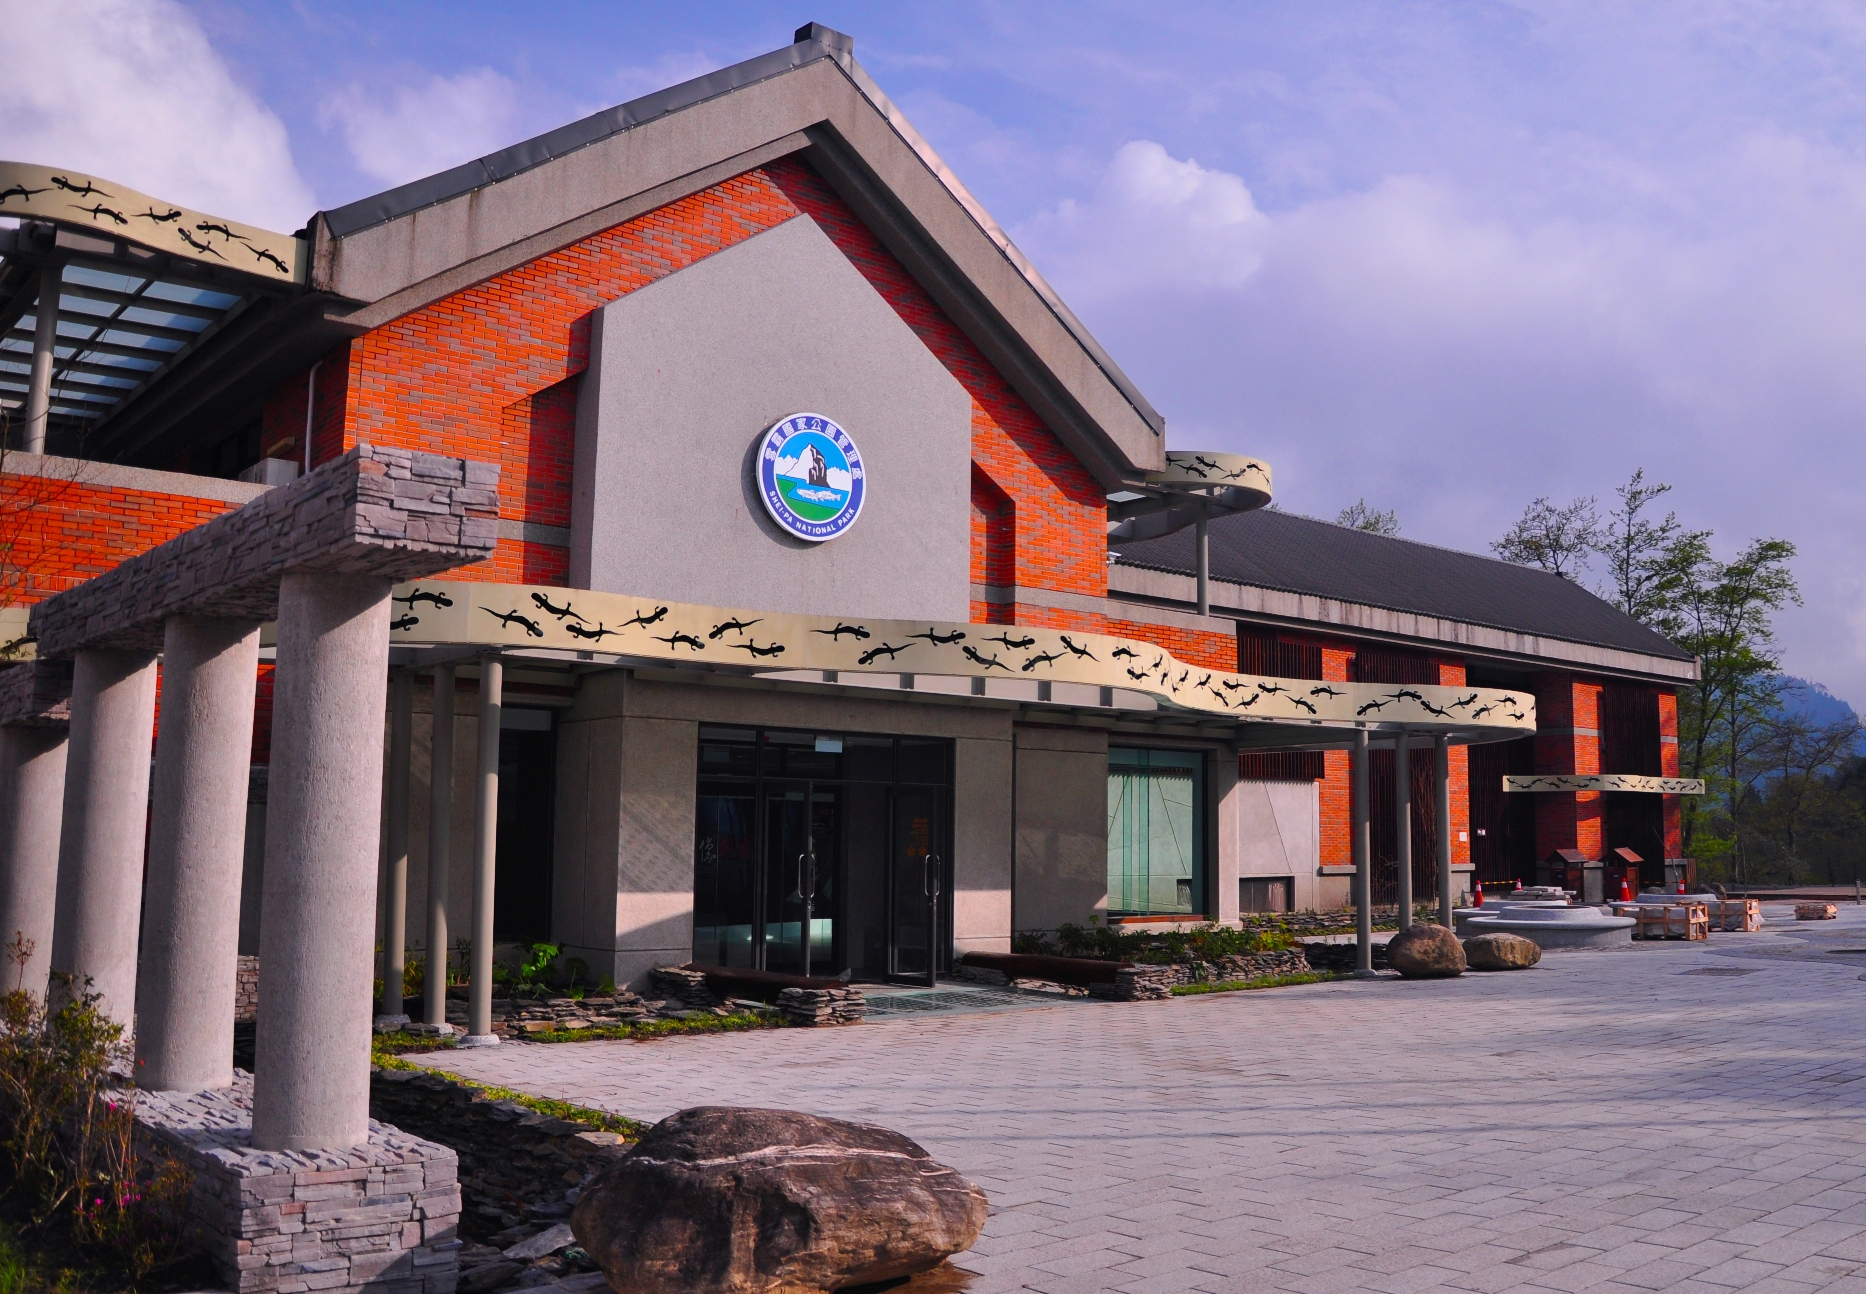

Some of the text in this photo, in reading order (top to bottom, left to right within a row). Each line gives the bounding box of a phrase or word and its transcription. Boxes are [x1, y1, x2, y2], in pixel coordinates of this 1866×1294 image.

[769, 490, 855, 534] SHEI-PA NATIONAL PARK
